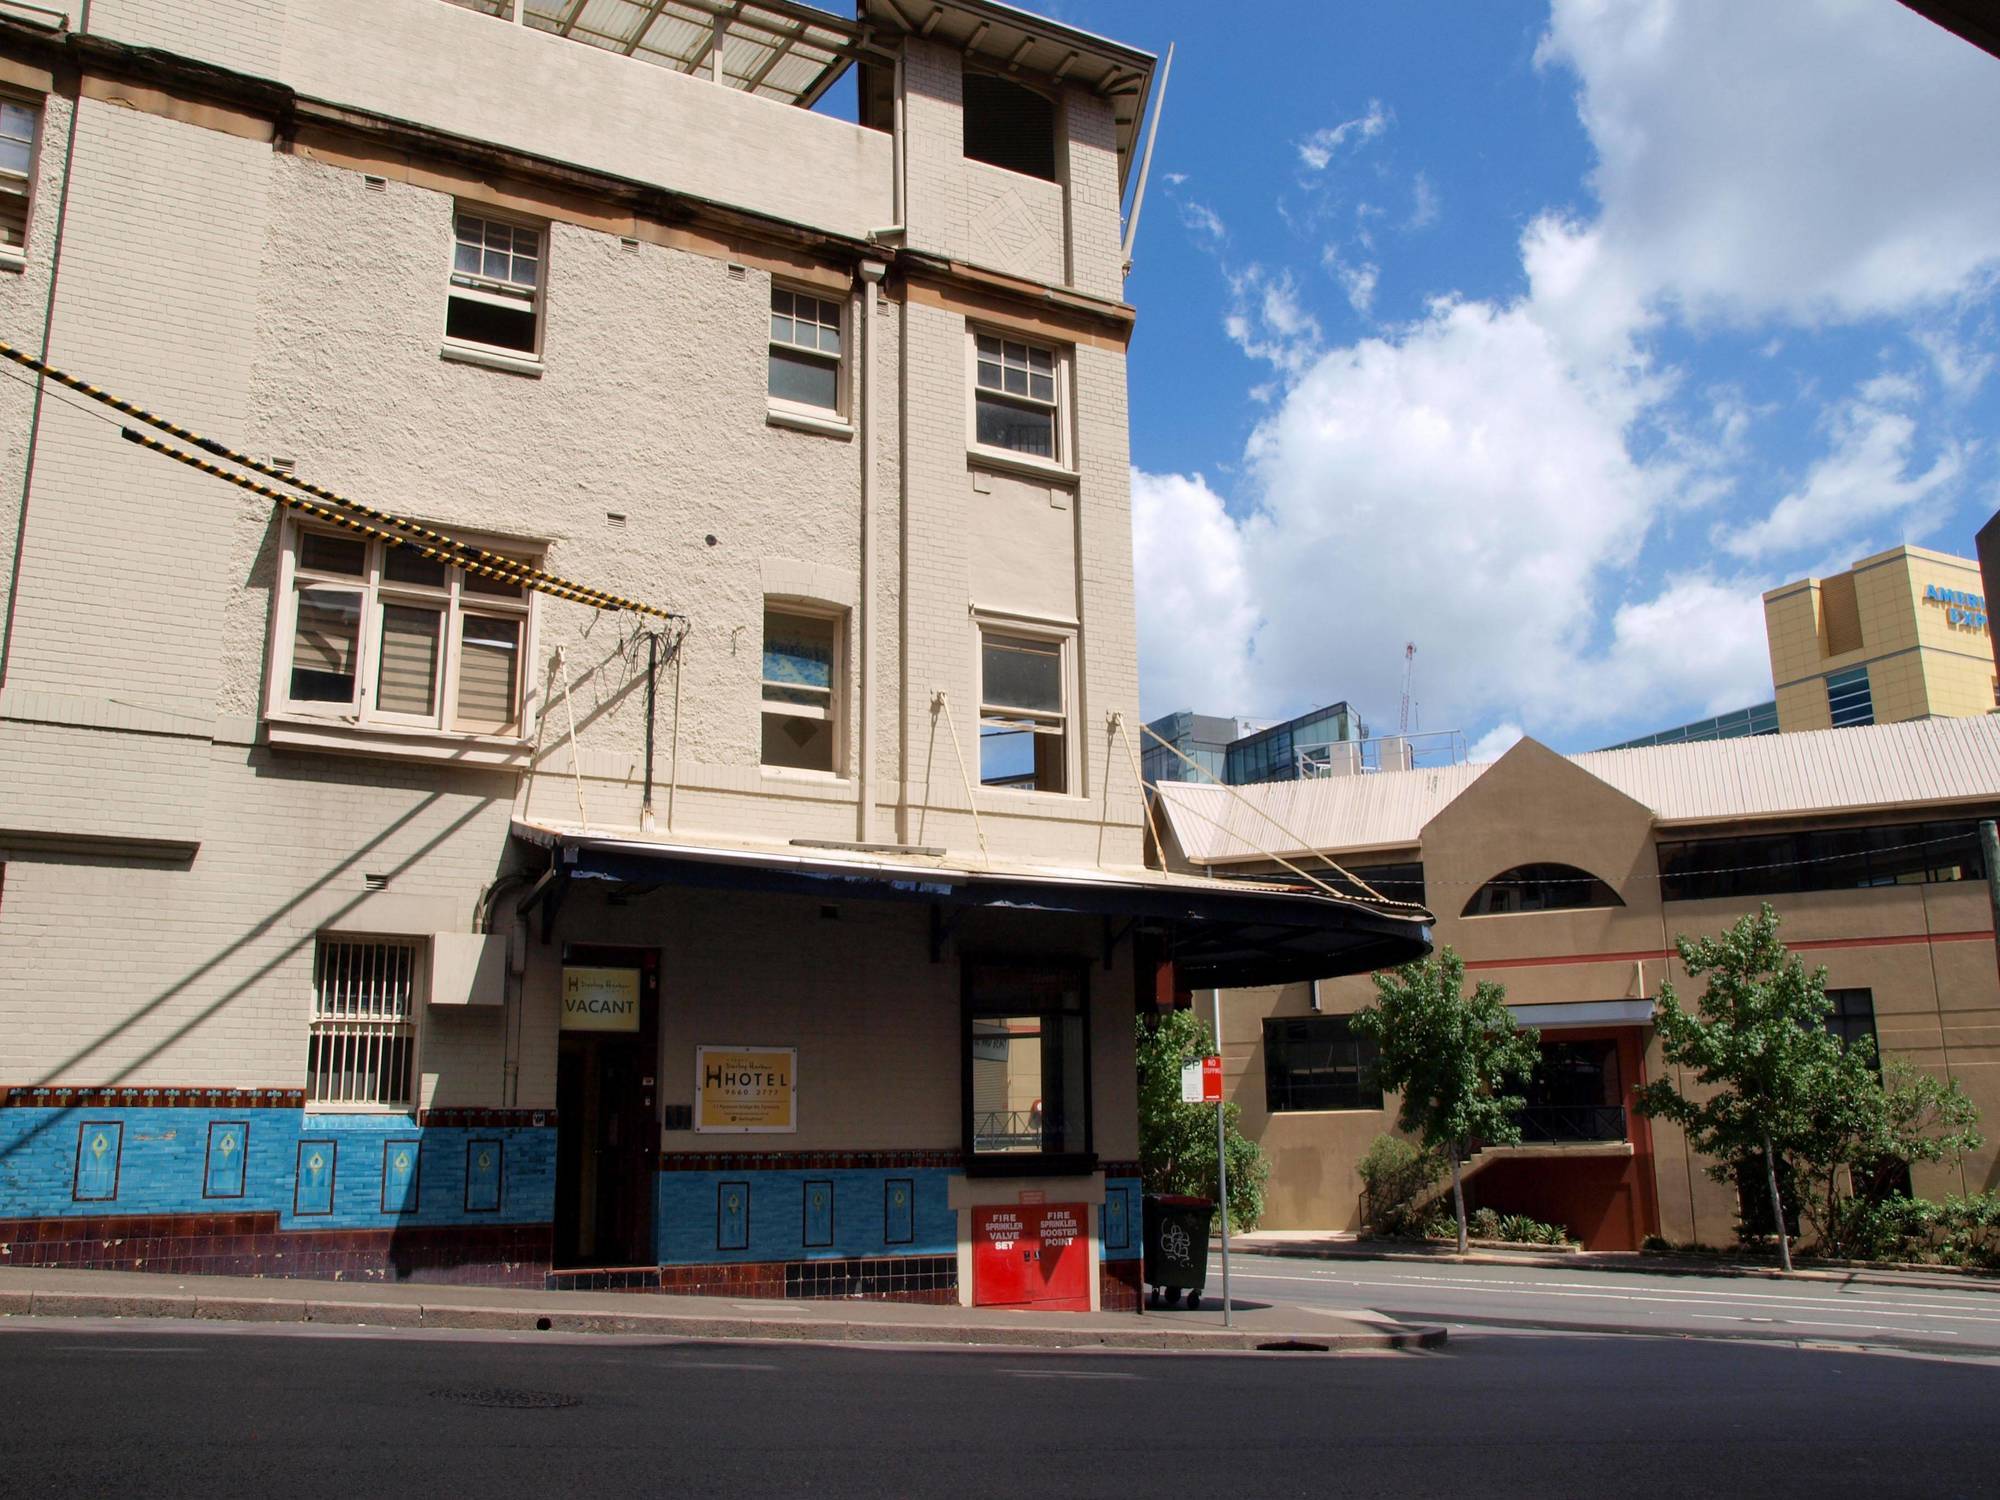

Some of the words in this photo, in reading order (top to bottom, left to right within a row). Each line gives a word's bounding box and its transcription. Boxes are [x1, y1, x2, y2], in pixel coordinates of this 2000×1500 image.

[565, 999, 634, 1014] VACANT
[1183, 1059, 1200, 1071] 2P
[725, 1073, 787, 1087] HOTEL
[993, 1214, 1016, 1222] FIRE
[1047, 1211, 1070, 1220] FIRE
[985, 1222, 1023, 1231] SPRINKLER
[1040, 1220, 1077, 1229] SPRINKLER
[990, 1232, 1019, 1240] VALVE
[1040, 1228, 1078, 1237] BOOSTER
[995, 1241, 1014, 1250] SET
[1045, 1238, 1073, 1247] POINT
